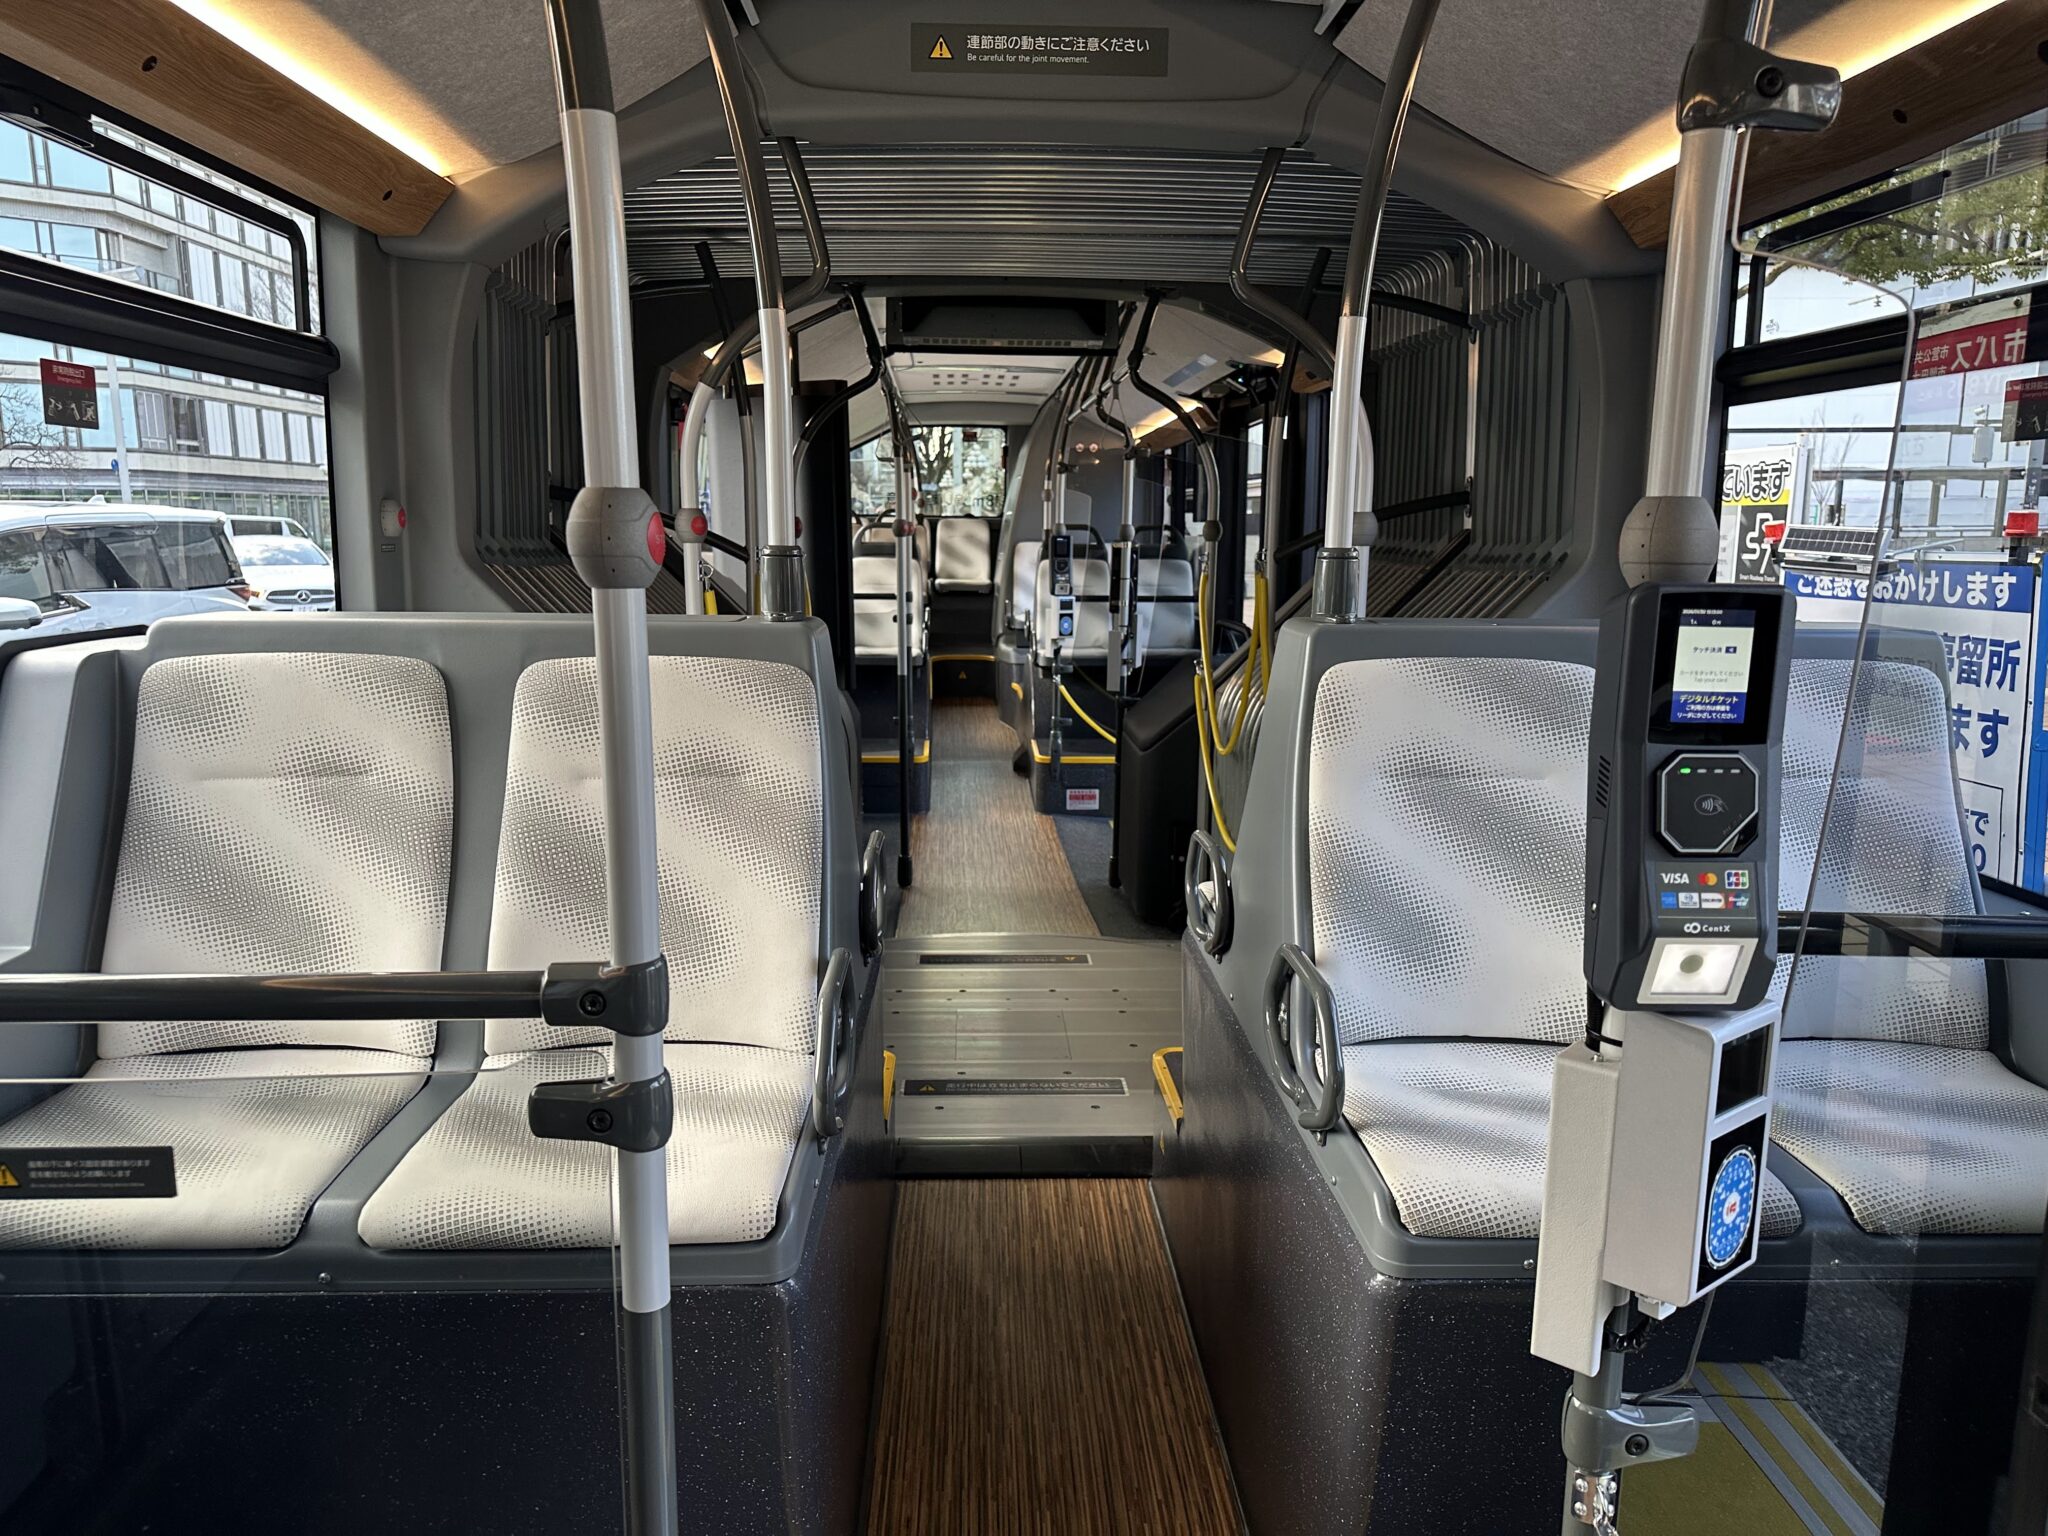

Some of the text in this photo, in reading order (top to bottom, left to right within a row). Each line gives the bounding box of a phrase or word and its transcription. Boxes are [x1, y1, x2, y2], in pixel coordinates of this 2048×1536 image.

[967, 35, 1150, 52] 連節部の動きにご注意ください
[967, 53, 977, 61] Be
[978, 53, 1004, 62] careful
[1006, 54, 1016, 62] for
[1018, 54, 1030, 62] the
[1031, 55, 1047, 64] joint
[1680, 695, 1738, 704] デジタルチケット
[1660, 873, 1689, 884] VISA
